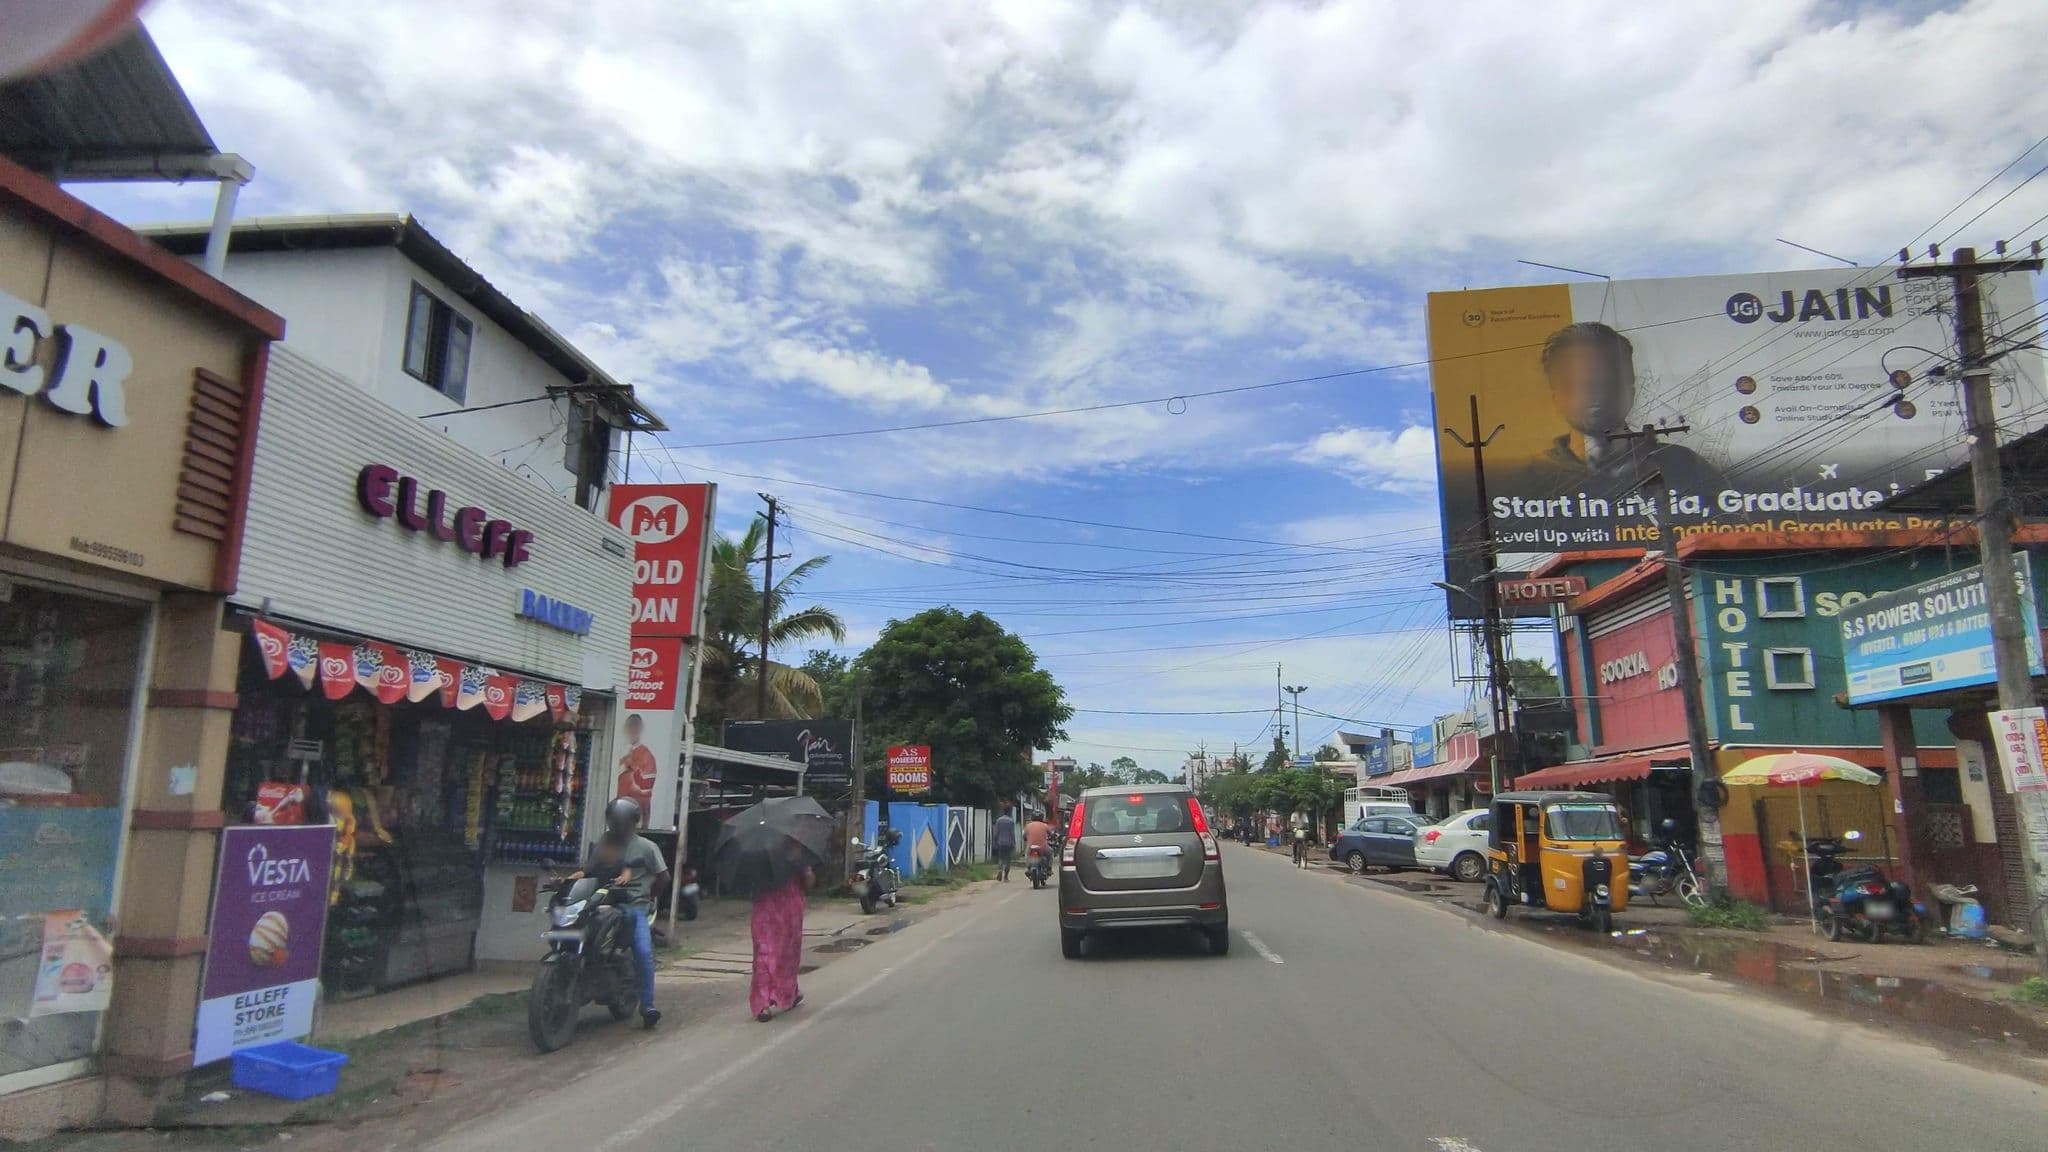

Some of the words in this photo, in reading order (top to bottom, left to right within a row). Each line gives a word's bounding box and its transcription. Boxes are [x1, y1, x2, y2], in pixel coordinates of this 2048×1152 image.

[1767, 286, 1893, 323] JAIN
[1795, 374, 1823, 382] Above
[1492, 496, 1573, 519] Start
[1578, 493, 1608, 517] in
[1718, 486, 1884, 513] Graduate
[357, 463, 534, 568] ELLEFF
[1543, 529, 1567, 546] Up
[1571, 527, 1610, 543] with
[633, 560, 684, 585] OLD
[1504, 580, 1580, 600] HOTEL
[521, 587, 595, 636] BAKERY
[1866, 601, 1922, 633] POWER
[1716, 579, 1754, 731] HOTEL
[631, 669, 652, 679] The
[1601, 651, 1650, 685] SOORYA
[627, 692, 656, 703] roup
[890, 773, 928, 784] ROOMS
[248, 859, 310, 886] VESTA
[235, 987, 289, 1010] ELLEFF
[235, 1003, 285, 1026] STORE
